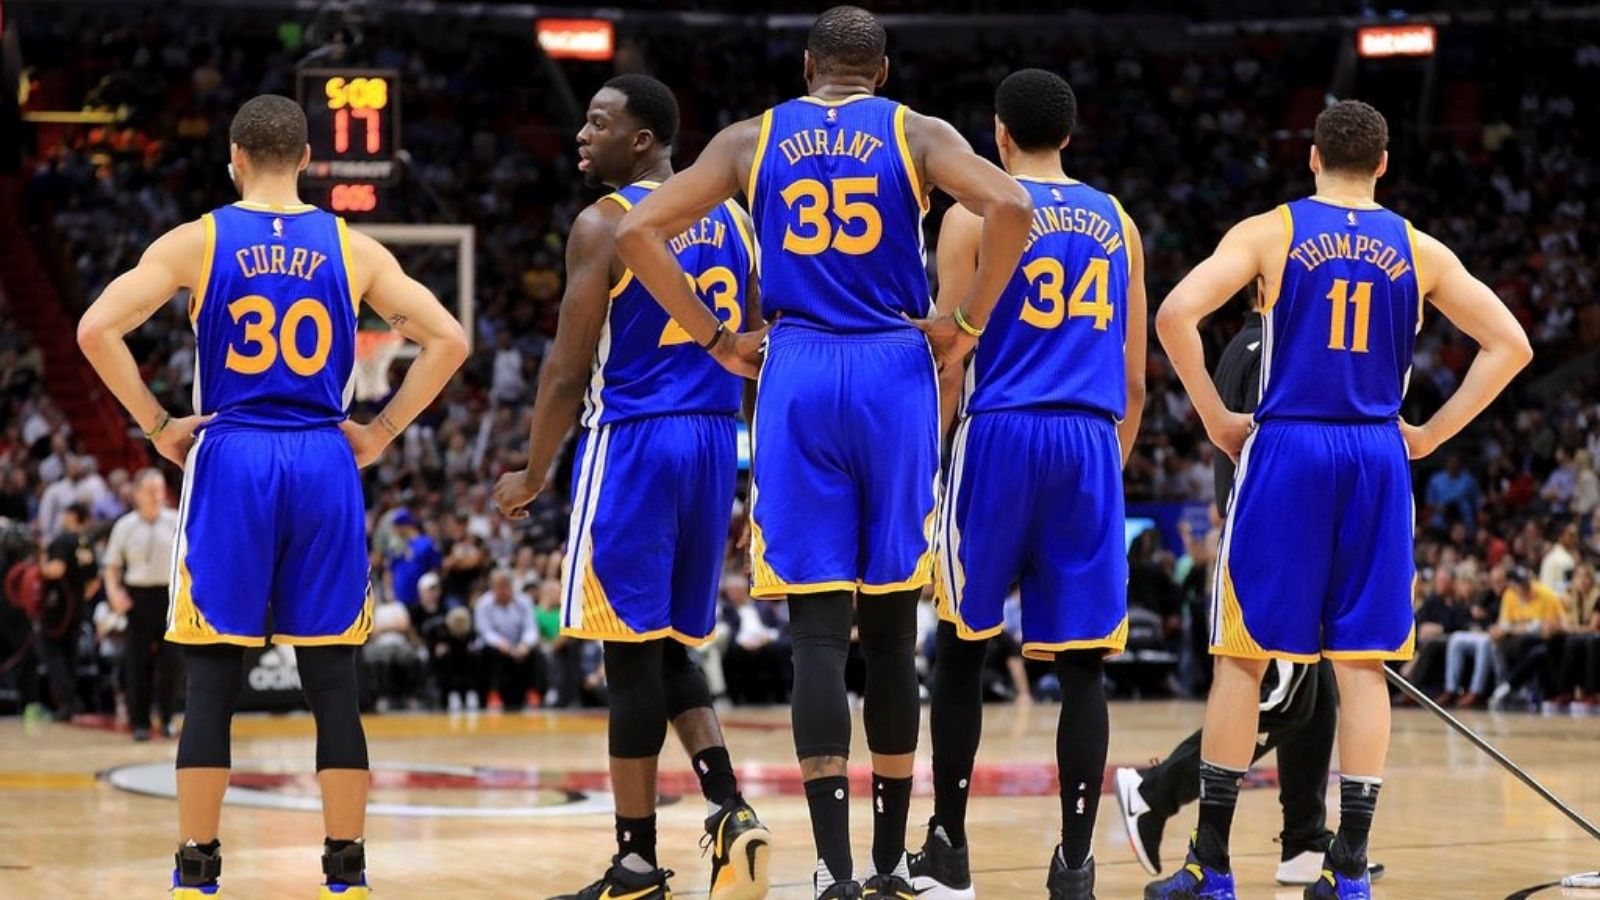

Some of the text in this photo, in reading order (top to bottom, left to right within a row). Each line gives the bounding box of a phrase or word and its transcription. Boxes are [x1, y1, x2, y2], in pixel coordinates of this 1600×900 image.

[335, 109, 380, 153] 17
[778, 128, 884, 166] DURANT
[779, 173, 883, 255] 35
[1023, 206, 1124, 255] VINGSTON
[235, 244, 327, 280] CURRY
[1289, 232, 1412, 282] THOMPSON
[1018, 256, 1114, 331] 34
[1326, 278, 1374, 353] 11
[225, 294, 334, 377] 30
